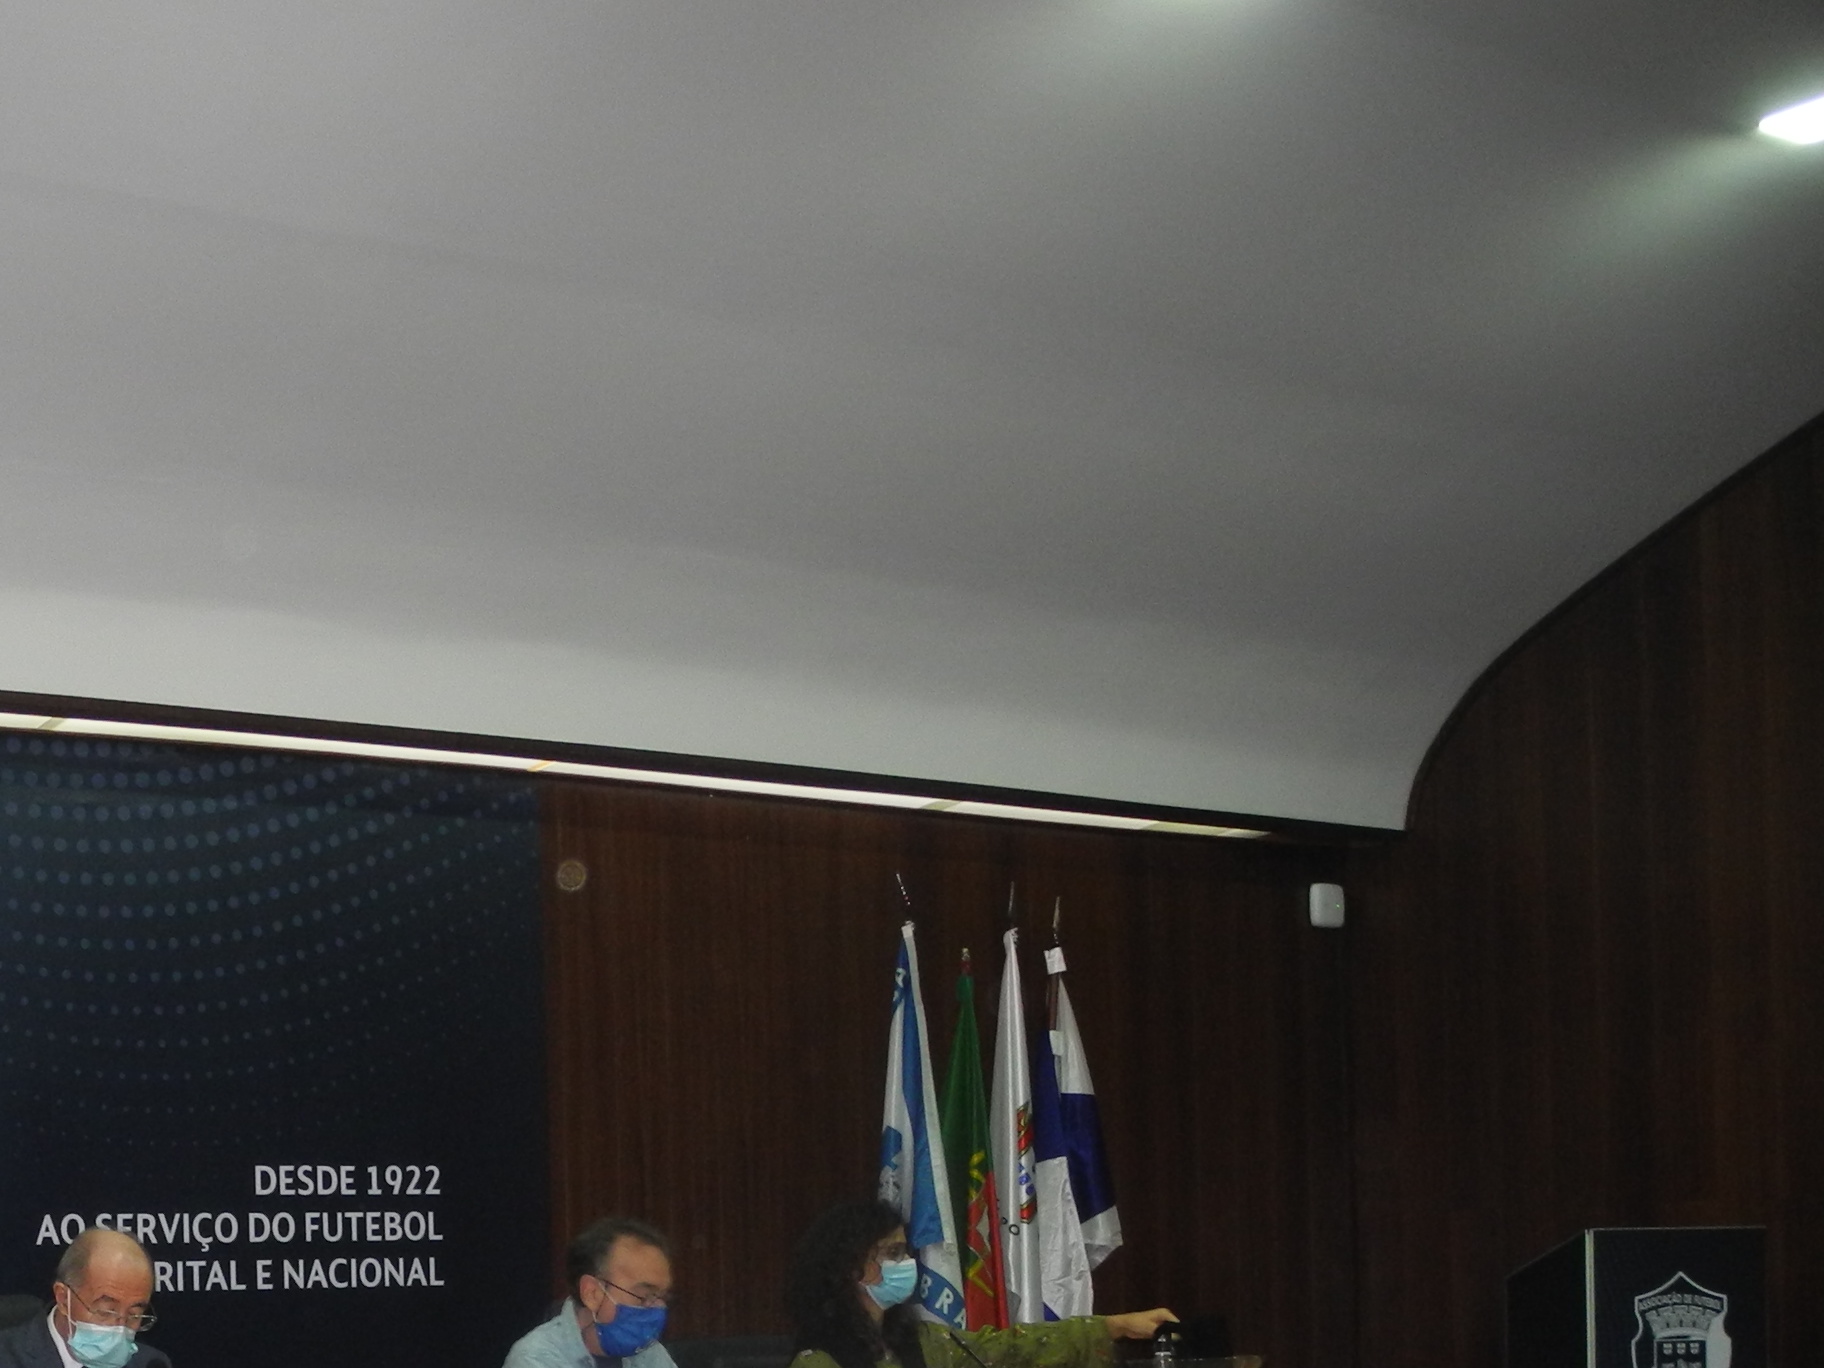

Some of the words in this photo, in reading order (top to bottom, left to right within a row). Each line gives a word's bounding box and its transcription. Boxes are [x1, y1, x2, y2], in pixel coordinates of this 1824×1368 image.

[255, 1165, 357, 1196] DESDE
[366, 1164, 442, 1195] 1922
[36, 1213, 80, 1246] AO
[248, 1212, 296, 1244] DO
[305, 1211, 443, 1242] FUTEBOL
[155, 1259, 247, 1292] RITAL
[256, 1258, 273, 1291] E
[283, 1257, 444, 1290] NACIONAL
